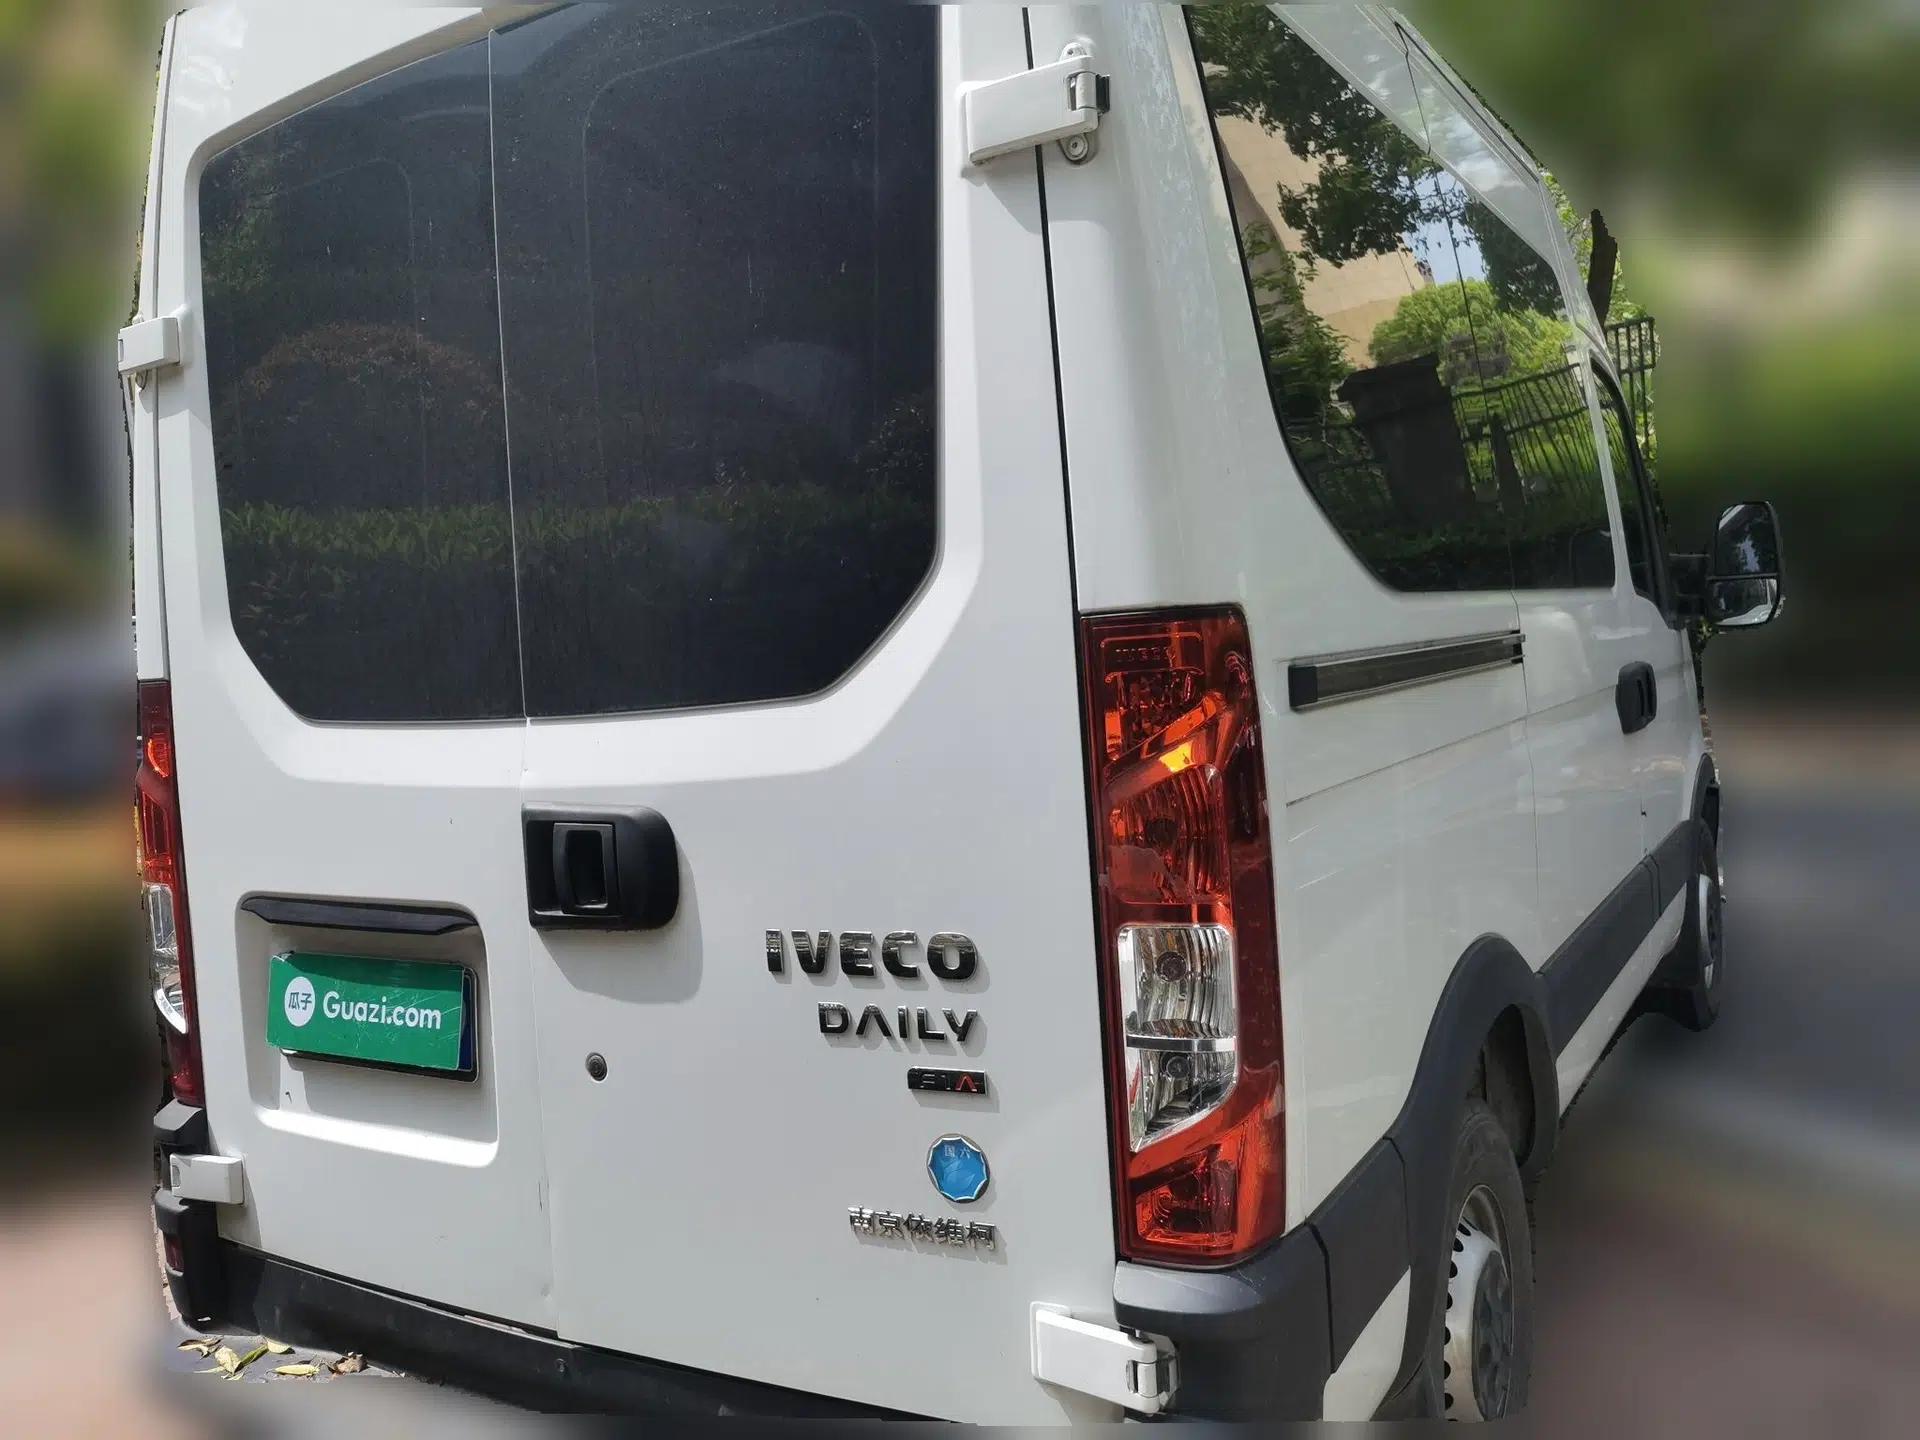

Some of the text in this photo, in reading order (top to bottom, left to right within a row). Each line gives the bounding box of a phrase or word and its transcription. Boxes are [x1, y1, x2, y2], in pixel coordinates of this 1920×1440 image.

[765, 929, 978, 980] IVECO
[287, 991, 313, 1010] 瓜子
[322, 990, 442, 1030] Guazi.com
[817, 1001, 978, 1042] DAILY
[847, 1205, 997, 1250] 南京依维柯
